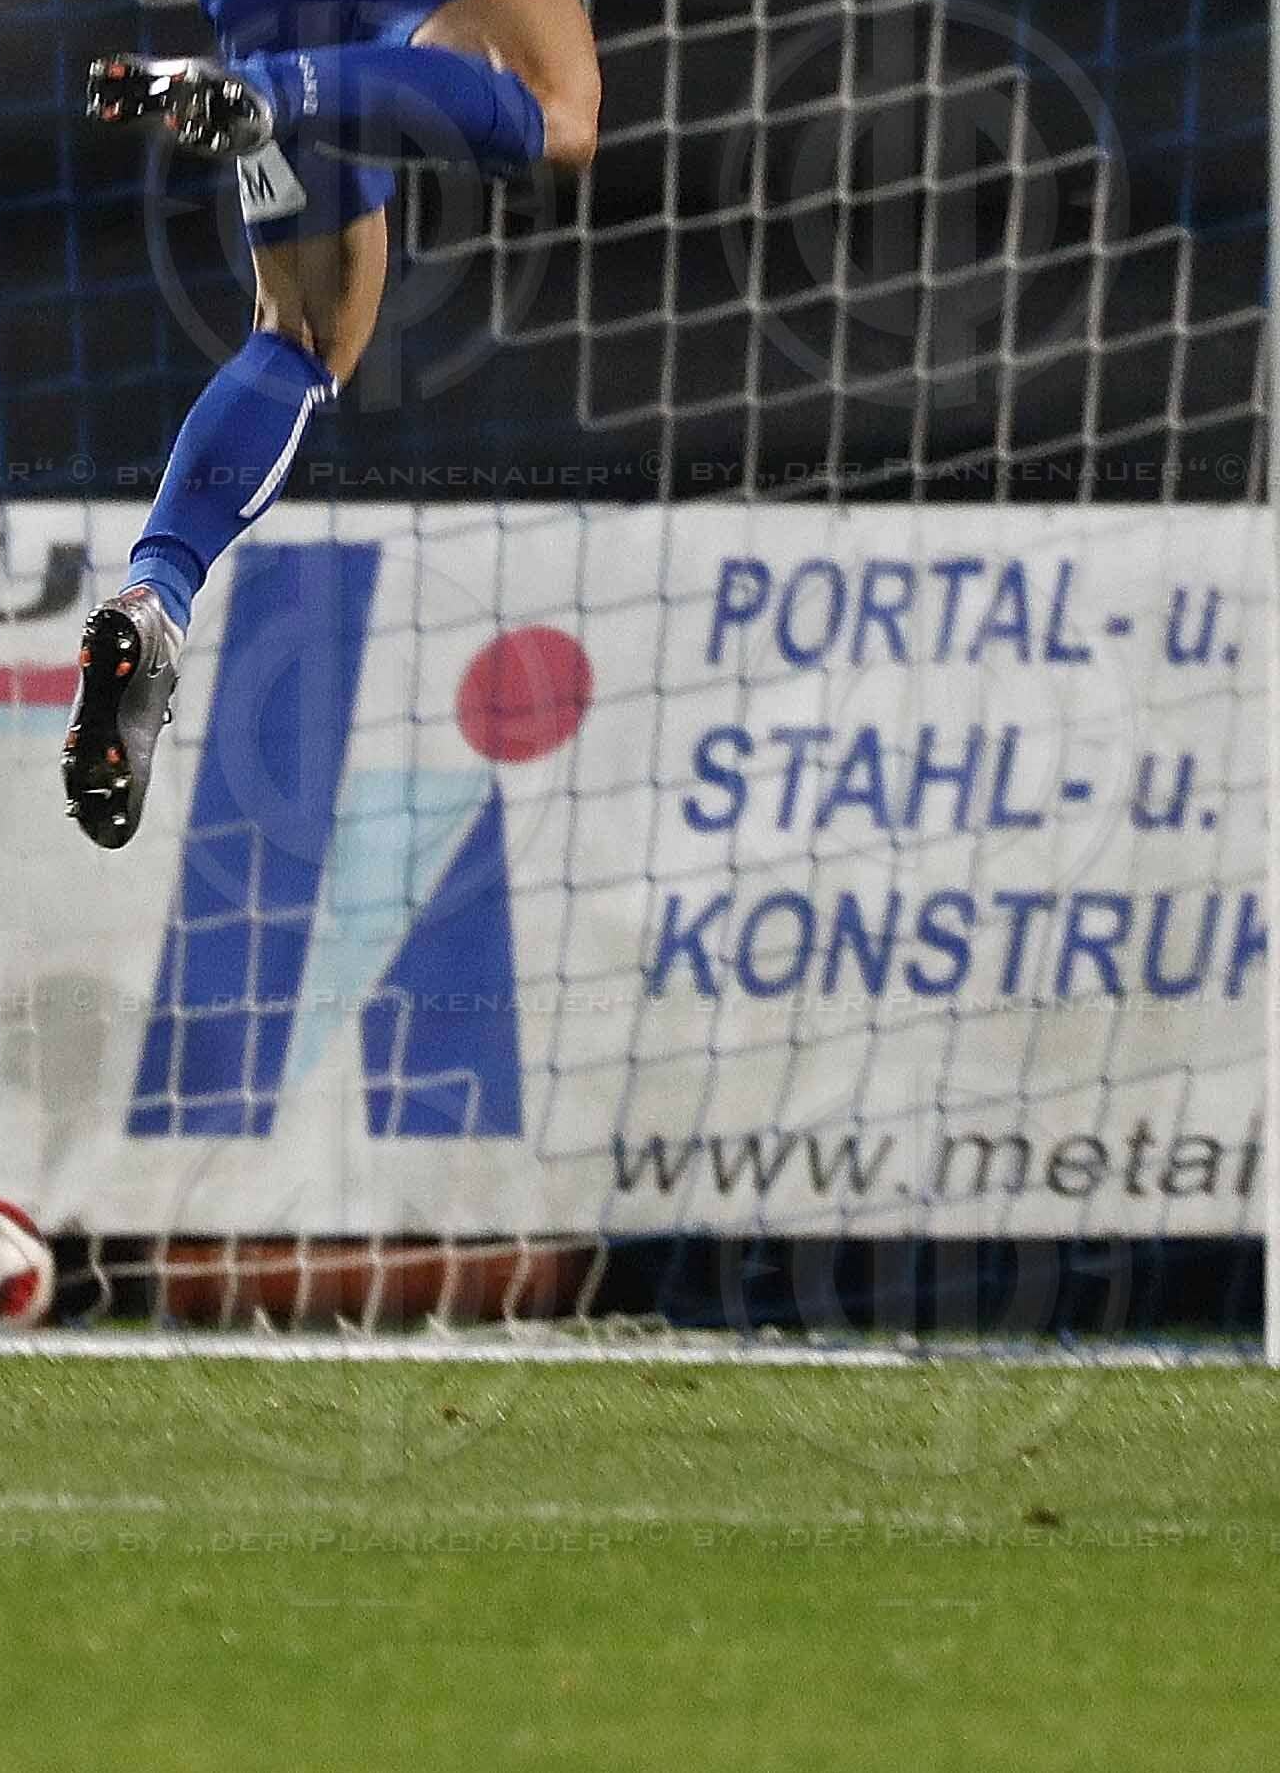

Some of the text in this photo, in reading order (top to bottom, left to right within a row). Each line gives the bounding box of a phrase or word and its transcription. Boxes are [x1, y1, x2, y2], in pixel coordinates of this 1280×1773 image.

[707, 557, 1131, 667] PORTAL-
[1166, 587, 1240, 666] u.
[682, 725, 1092, 832] STAHL-
[1131, 751, 1218, 829] u.
